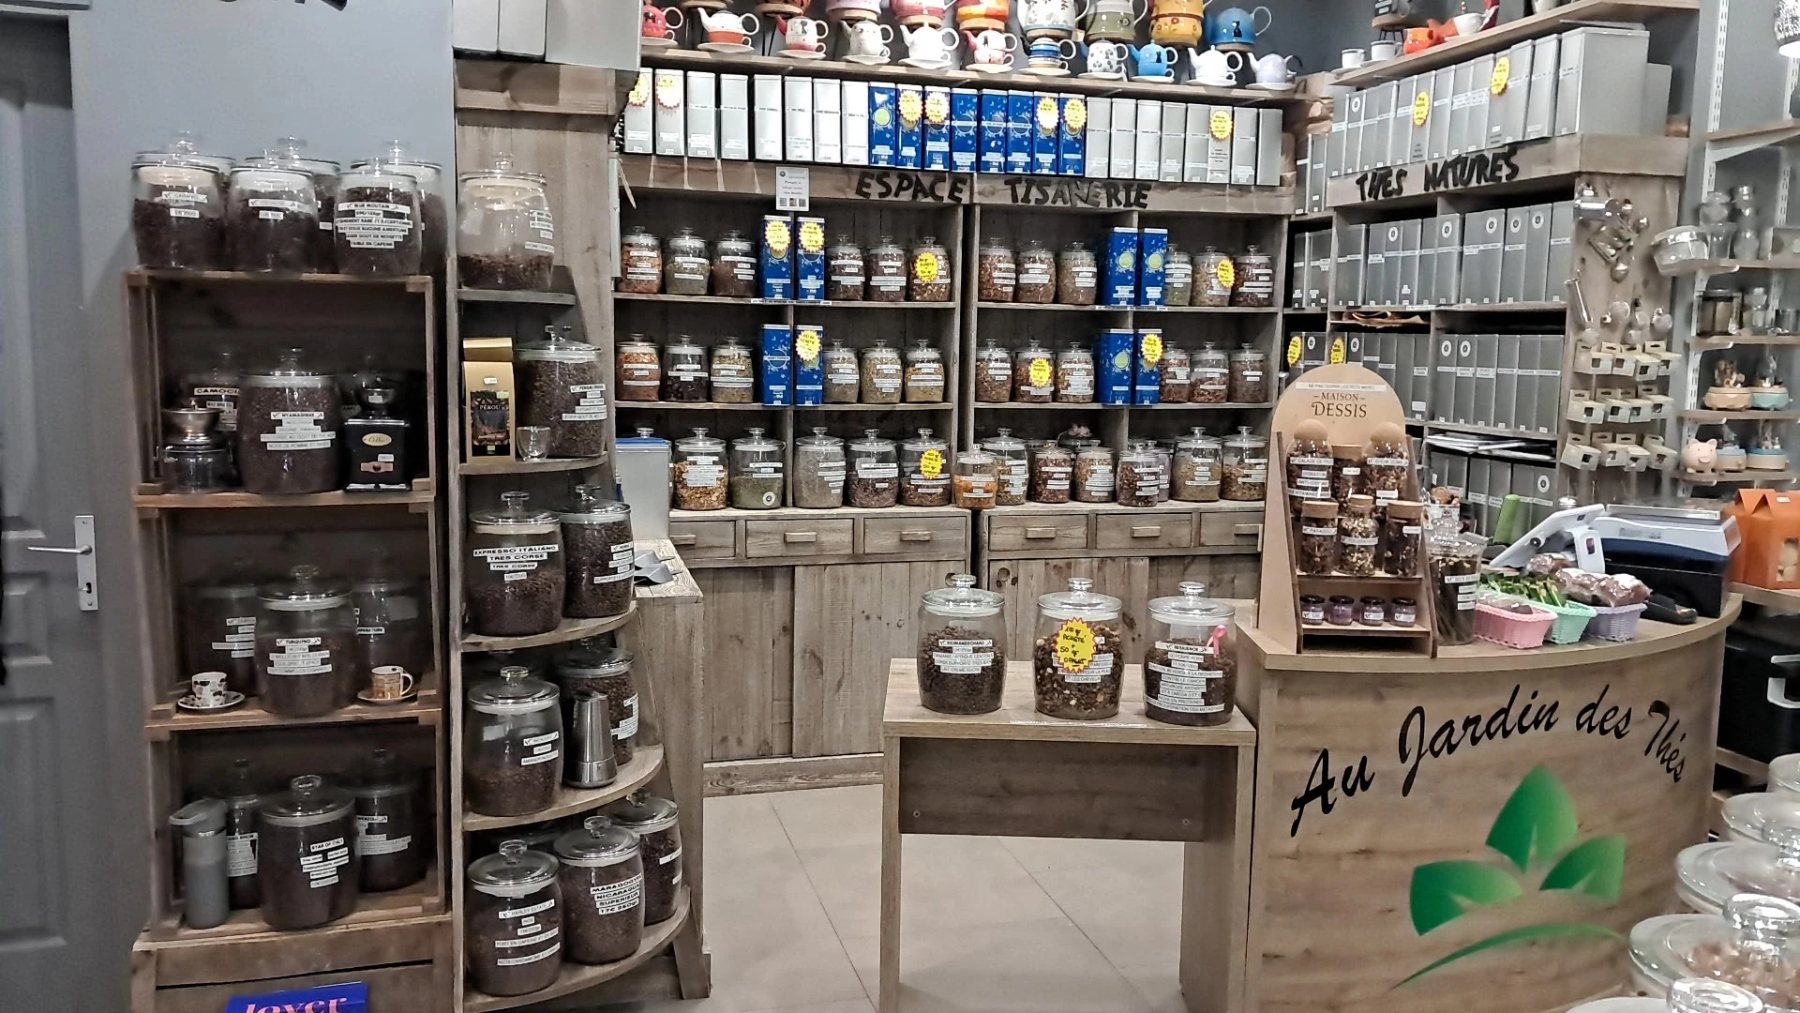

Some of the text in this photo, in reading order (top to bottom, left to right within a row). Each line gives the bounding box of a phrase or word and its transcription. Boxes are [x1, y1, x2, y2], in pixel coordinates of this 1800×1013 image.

[1355, 146, 1521, 202] THES NATURES
[855, 171, 1152, 210] ESPACE TISANERIE
[1311, 400, 1367, 418] DESSIS
[1320, 391, 1360, 401] MAISON
[519, 545, 556, 553] ITALIANO
[1290, 683, 1687, 838] Au Jardin des Thés
